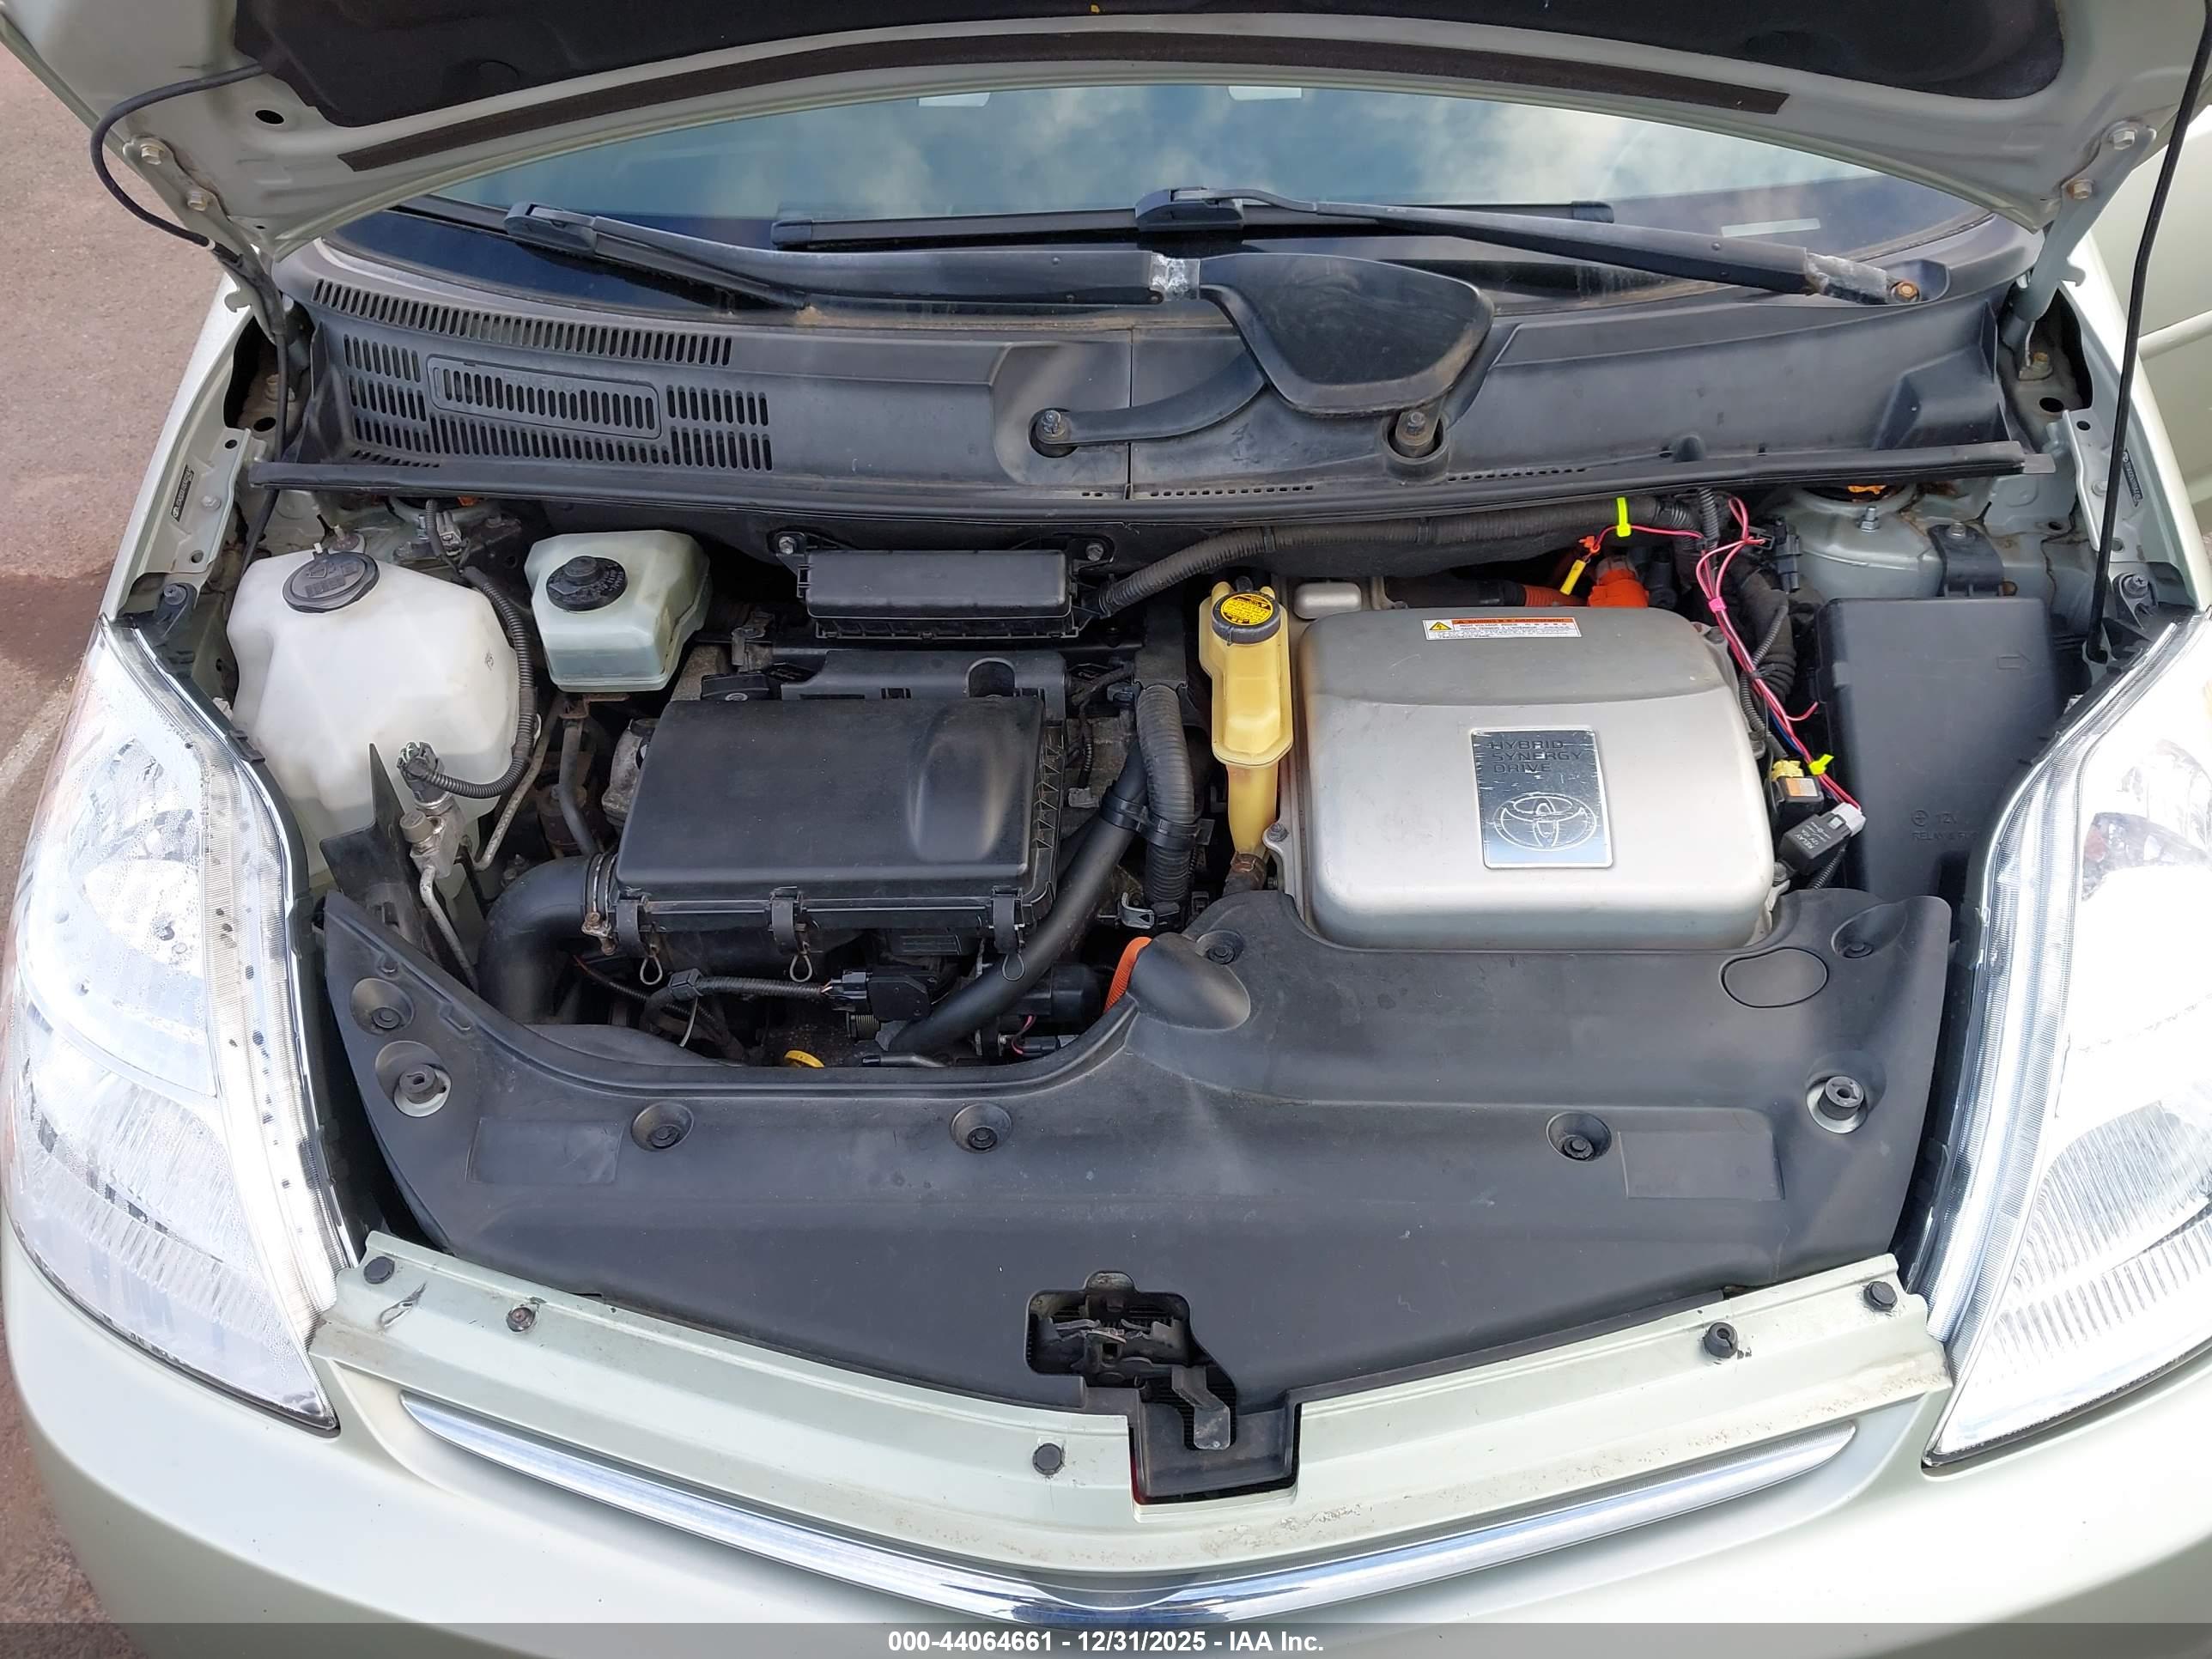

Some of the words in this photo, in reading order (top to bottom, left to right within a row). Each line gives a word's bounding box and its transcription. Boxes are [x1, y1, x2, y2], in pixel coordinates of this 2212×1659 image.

[1490, 740, 1564, 750] HYBRID
[1492, 751, 1582, 762] SYNERGY
[1494, 763, 1552, 773] DRIVE
